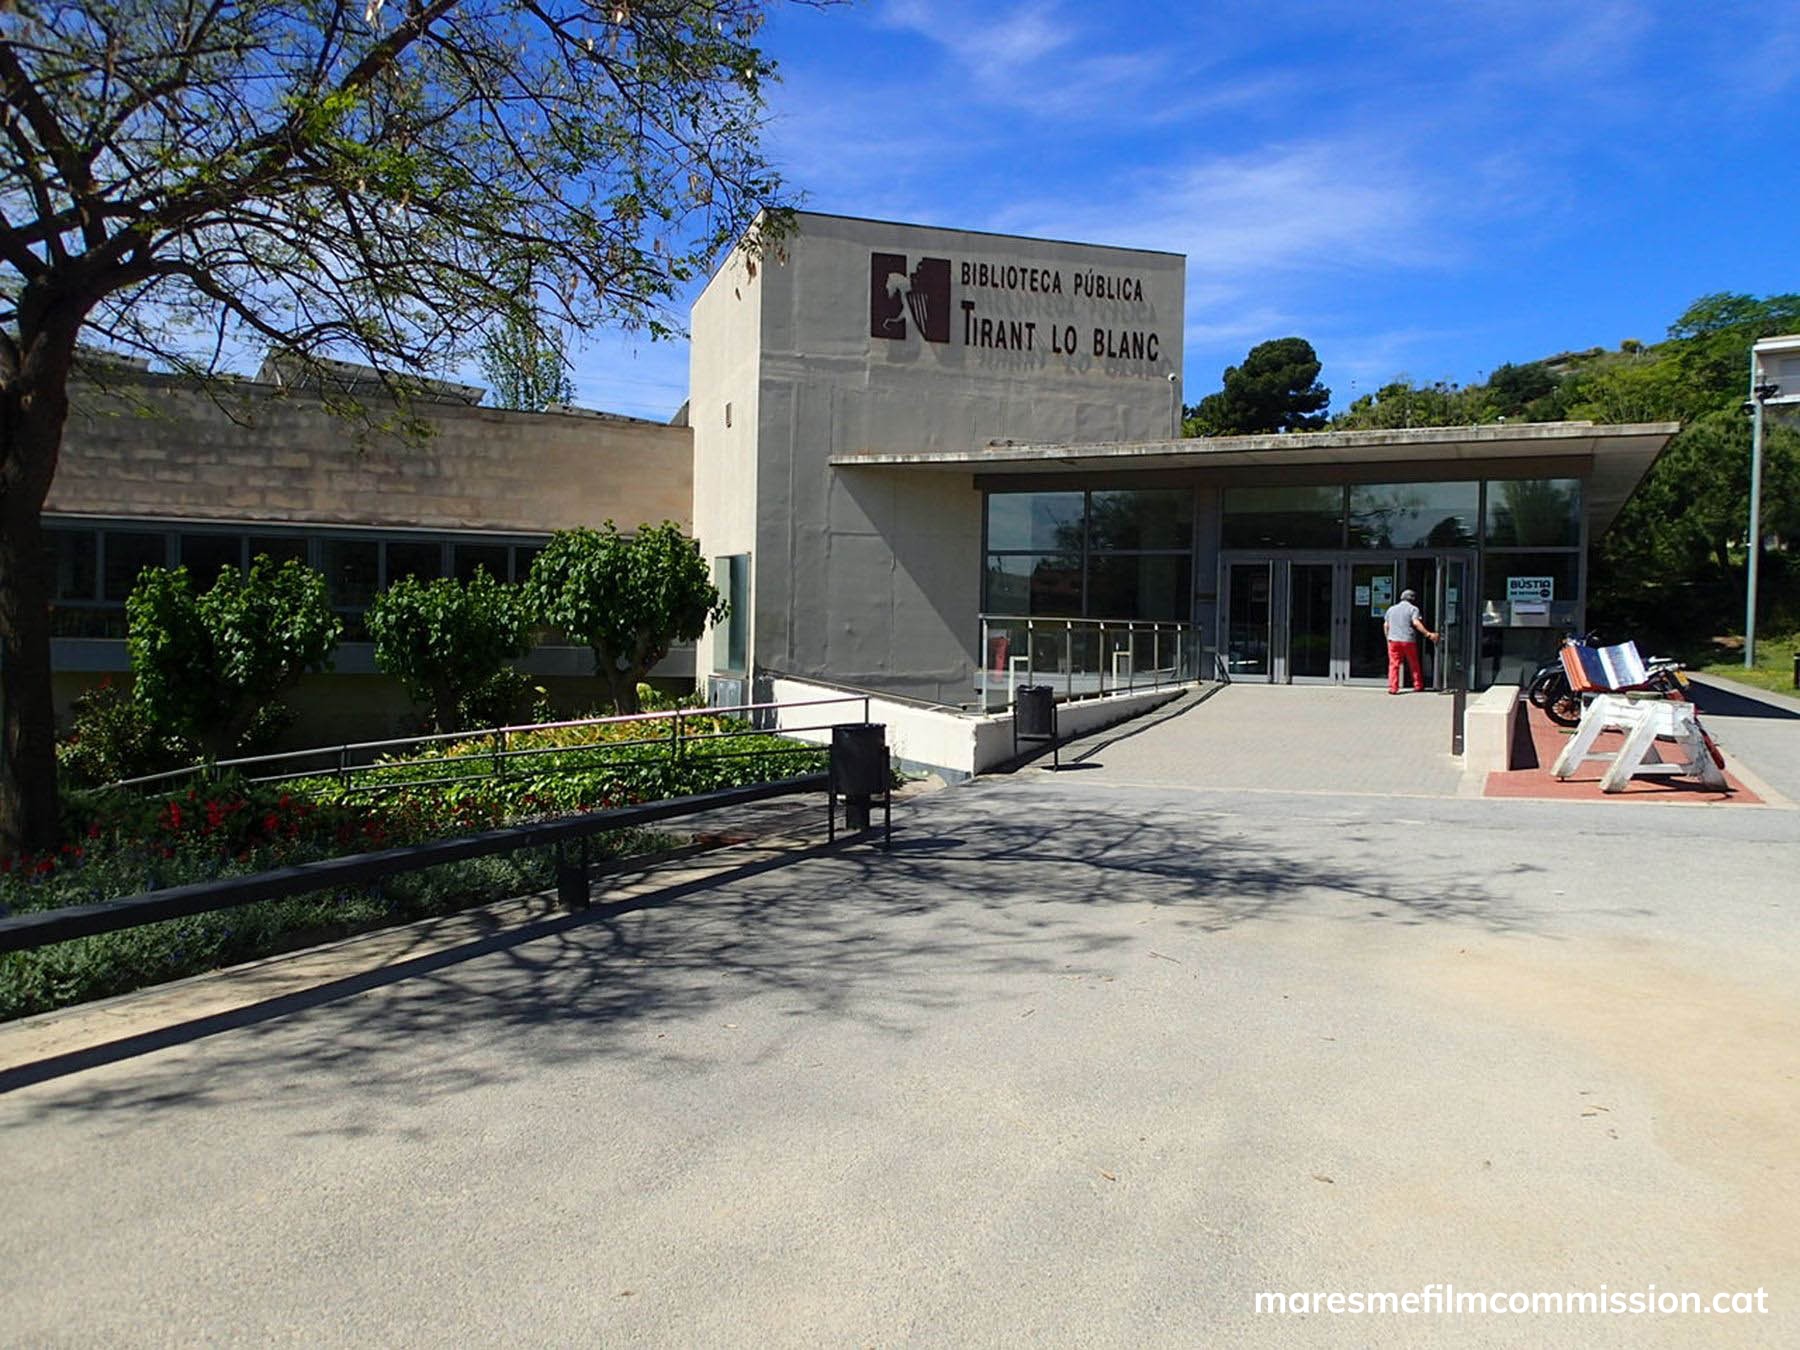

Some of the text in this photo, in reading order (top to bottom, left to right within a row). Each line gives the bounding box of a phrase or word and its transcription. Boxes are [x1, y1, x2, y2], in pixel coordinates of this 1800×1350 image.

[961, 262, 1143, 301] BIBLIOTECA PÚBLICA
[1052, 325, 1077, 355] LO
[1094, 328, 1159, 361] BLANC
